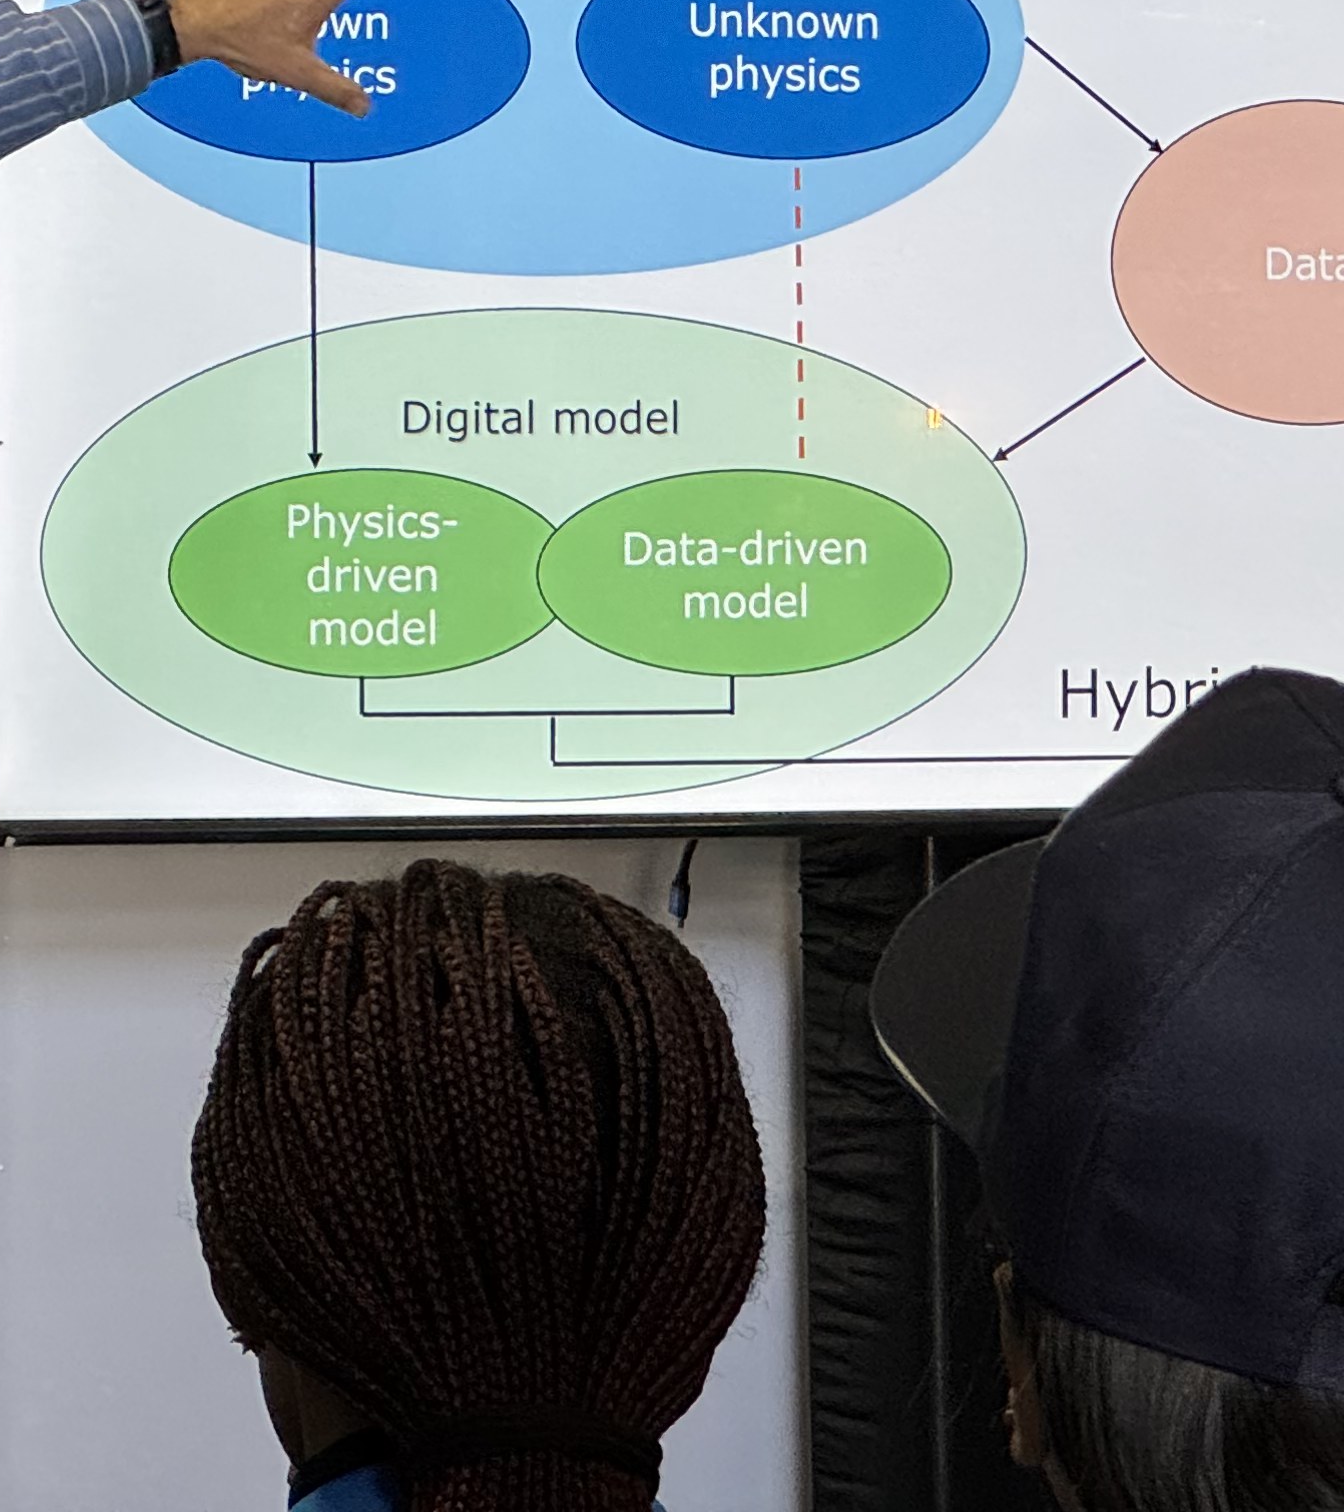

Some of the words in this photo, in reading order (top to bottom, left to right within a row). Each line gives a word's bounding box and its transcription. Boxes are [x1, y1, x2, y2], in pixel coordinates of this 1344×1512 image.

[690, 1, 879, 39] Unknown
[710, 54, 861, 100] physics
[404, 399, 534, 443] Digital
[554, 399, 678, 435] model
[288, 502, 458, 548] Physics-
[624, 529, 868, 566] Data-driven
[307, 556, 437, 593] driven
[684, 582, 807, 619] model
[310, 609, 436, 646] model
[1061, 665, 1219, 732] Hybr
